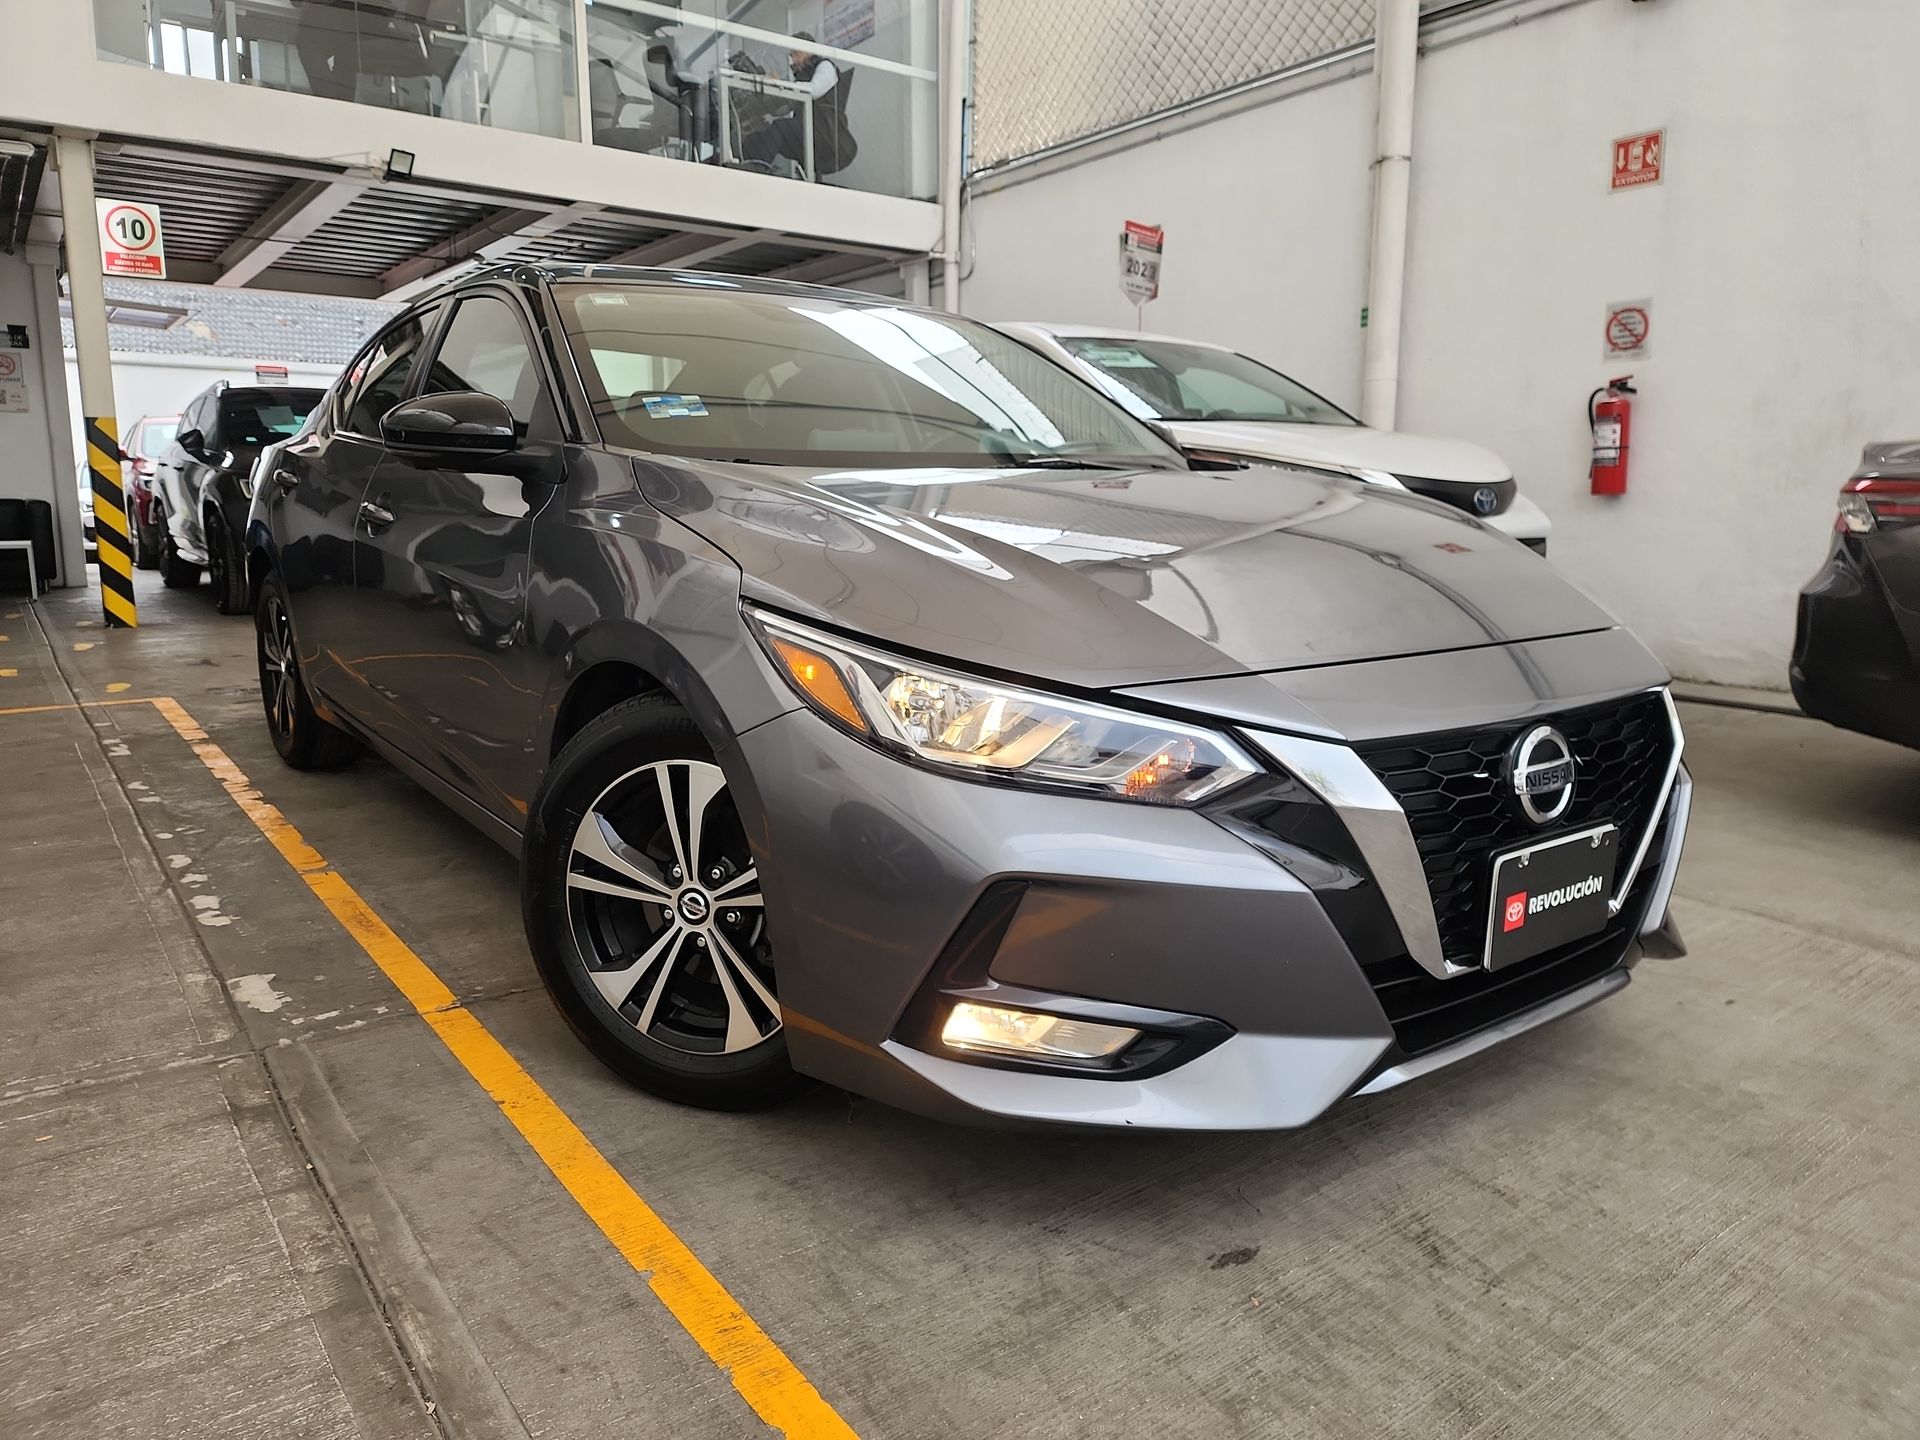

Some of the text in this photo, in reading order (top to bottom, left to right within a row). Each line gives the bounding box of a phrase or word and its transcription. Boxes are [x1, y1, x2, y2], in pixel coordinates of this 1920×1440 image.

[1615, 170, 1657, 187] EXTINTOR
[116, 217, 146, 241] 10
[1526, 766, 1572, 787] NISSAN
[1528, 874, 1603, 914] REVOLUCIÓN
